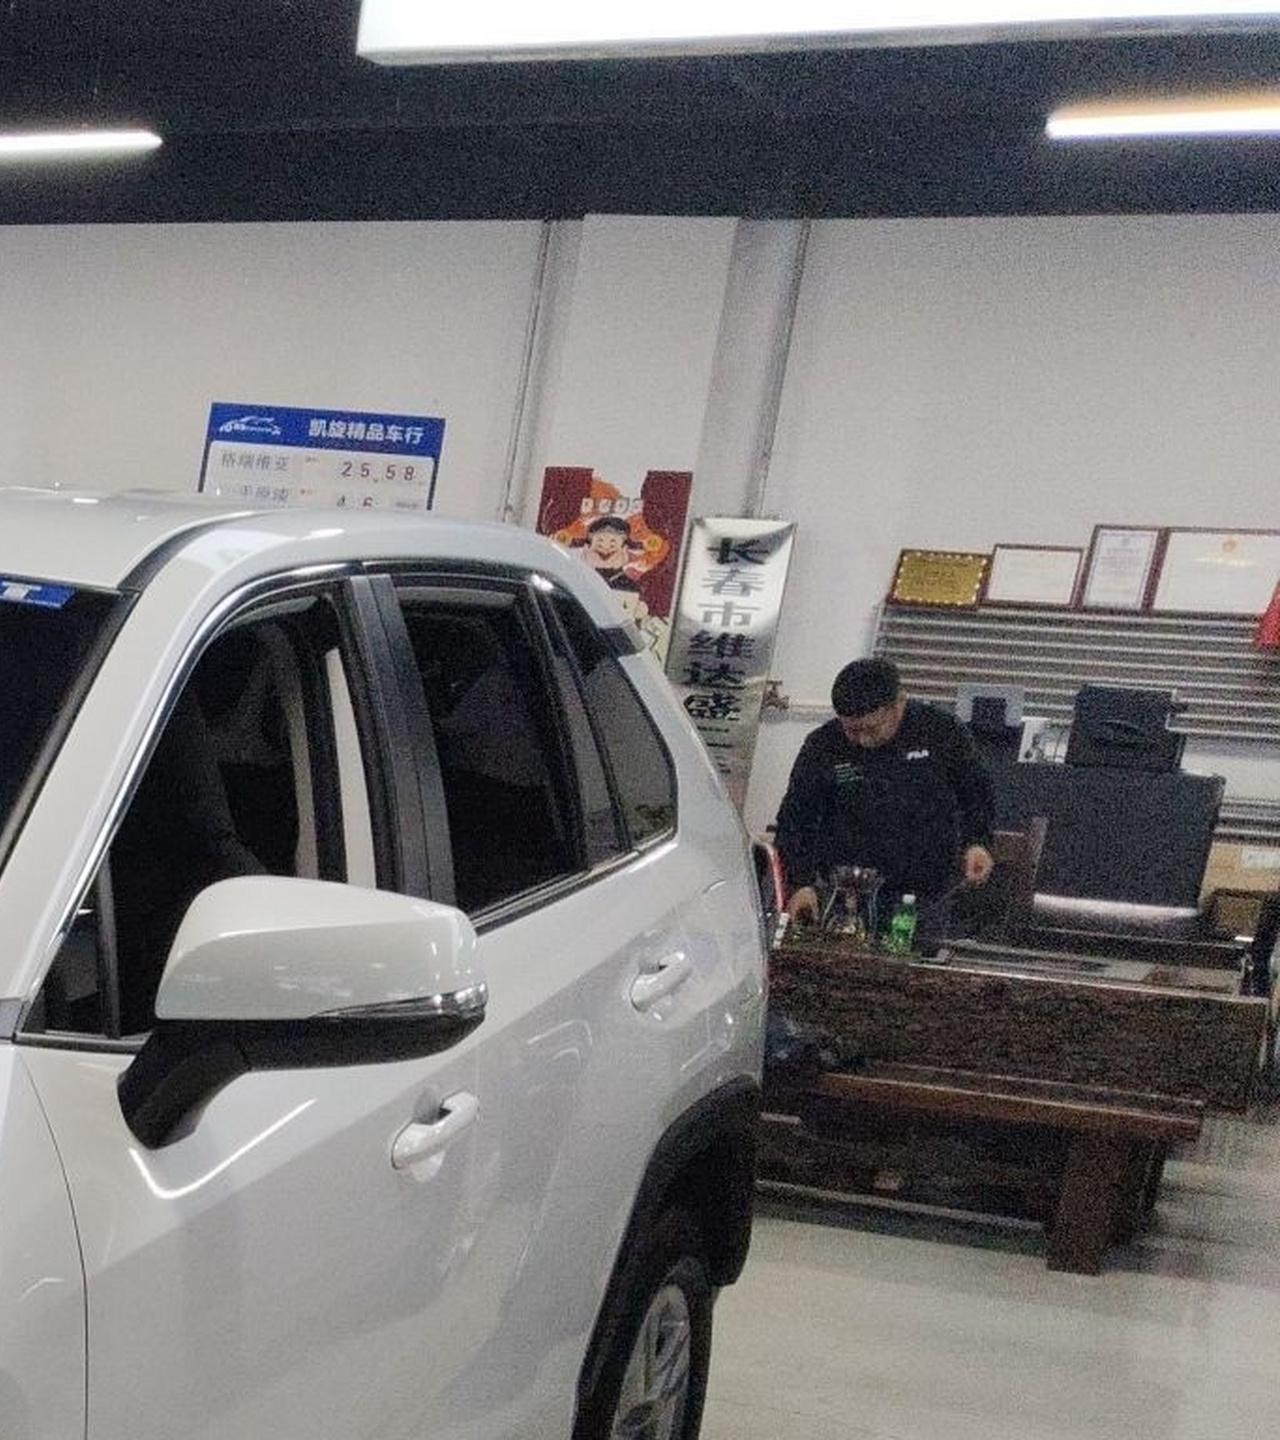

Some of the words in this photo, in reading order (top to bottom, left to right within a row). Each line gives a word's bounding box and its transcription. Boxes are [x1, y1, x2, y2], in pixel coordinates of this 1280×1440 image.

[308, 418, 424, 444] 凯旋精品车行
